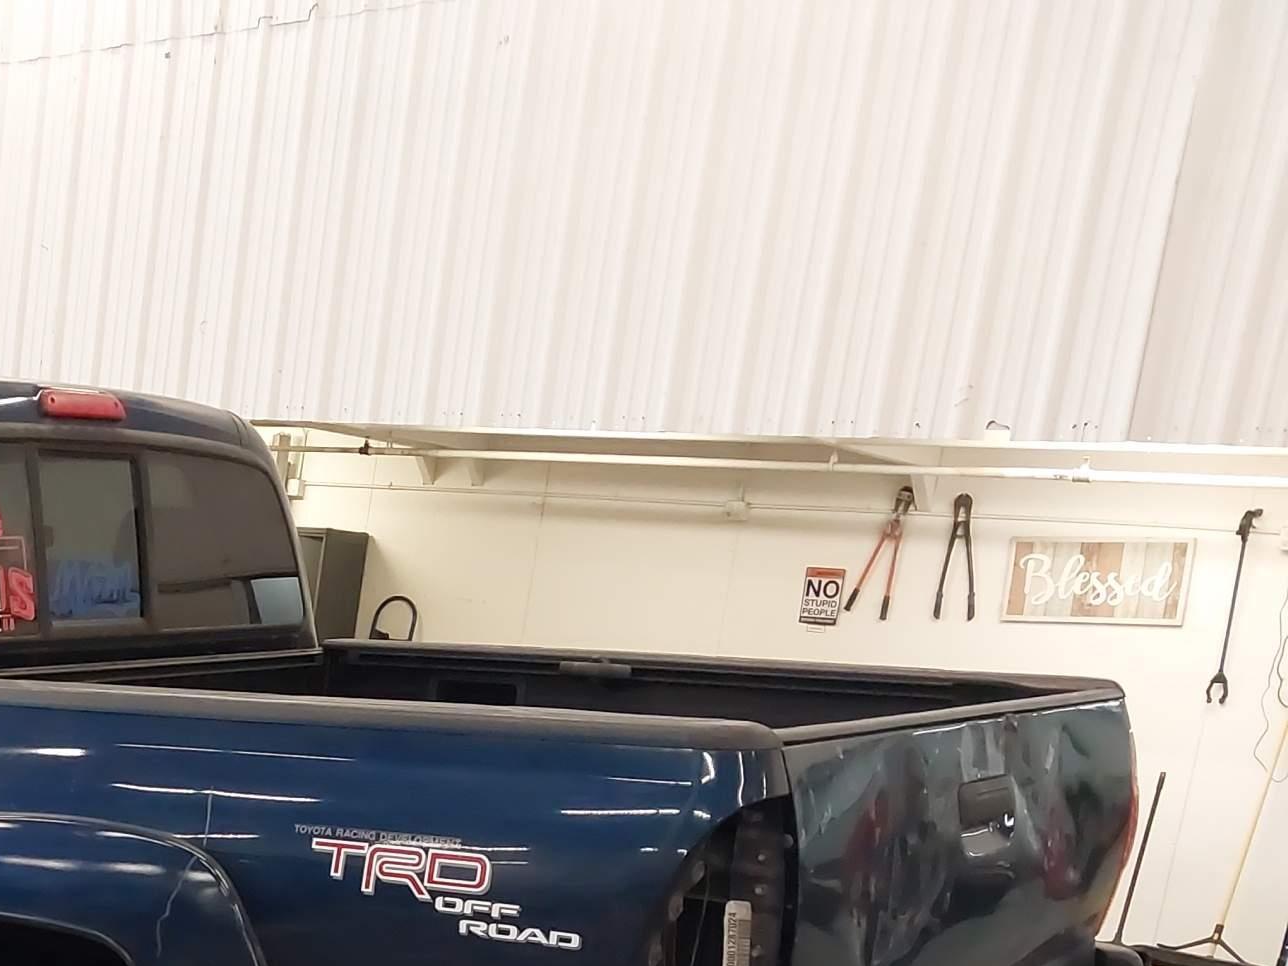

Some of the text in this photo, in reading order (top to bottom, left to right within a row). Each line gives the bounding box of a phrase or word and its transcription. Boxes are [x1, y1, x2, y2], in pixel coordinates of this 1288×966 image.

[805, 579, 840, 598] NO
[1019, 553, 1178, 606] Blessed
[802, 607, 837, 617] PEOPLE
[803, 598, 838, 608] STUPID
[294, 824, 333, 836] TOYOTA
[335, 828, 376, 841] RACING
[311, 838, 492, 903] TRD
[434, 896, 522, 918] OFF
[458, 919, 584, 951] ROAD
